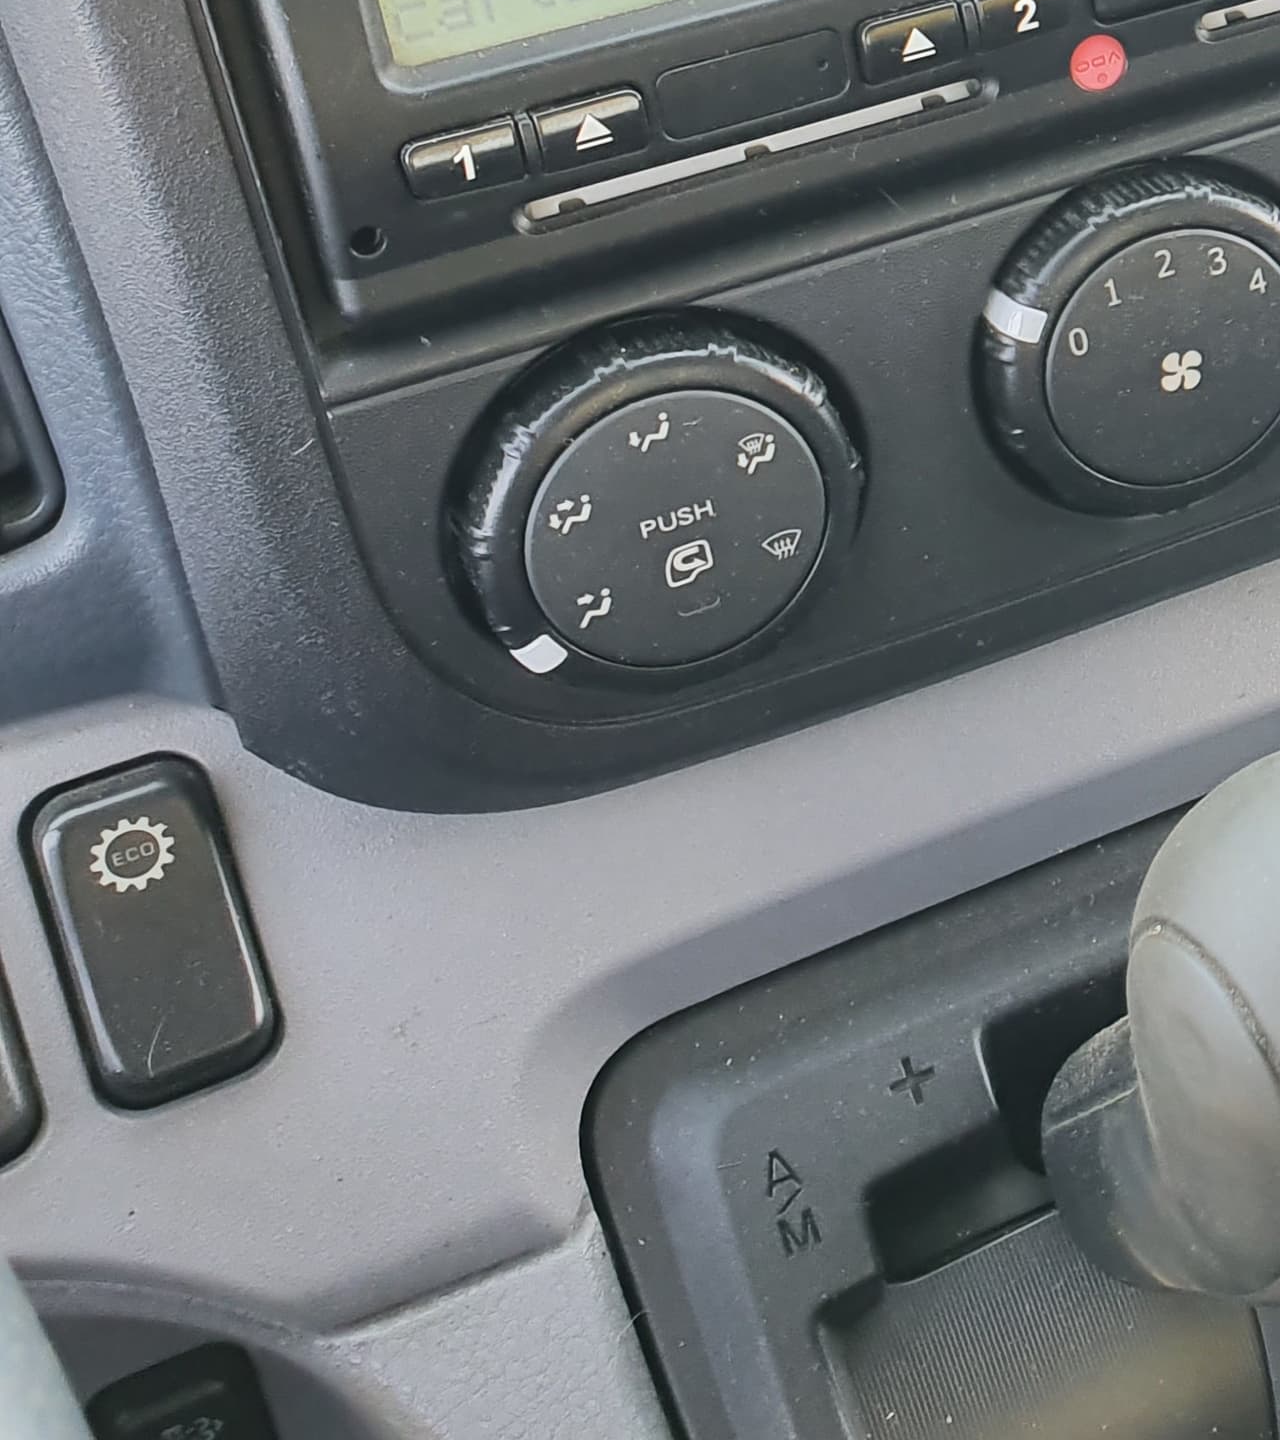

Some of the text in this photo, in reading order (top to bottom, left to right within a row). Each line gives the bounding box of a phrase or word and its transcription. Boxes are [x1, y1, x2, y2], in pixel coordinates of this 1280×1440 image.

[1014, 0, 1040, 33] 2
[453, 145, 477, 182] 1
[1067, 247, 1269, 357] 0 1 2 3 4
[640, 498, 716, 539] PUSH
[111, 840, 156, 869] ECO
[765, 1147, 802, 1199] A
[776, 1207, 822, 1258] M
